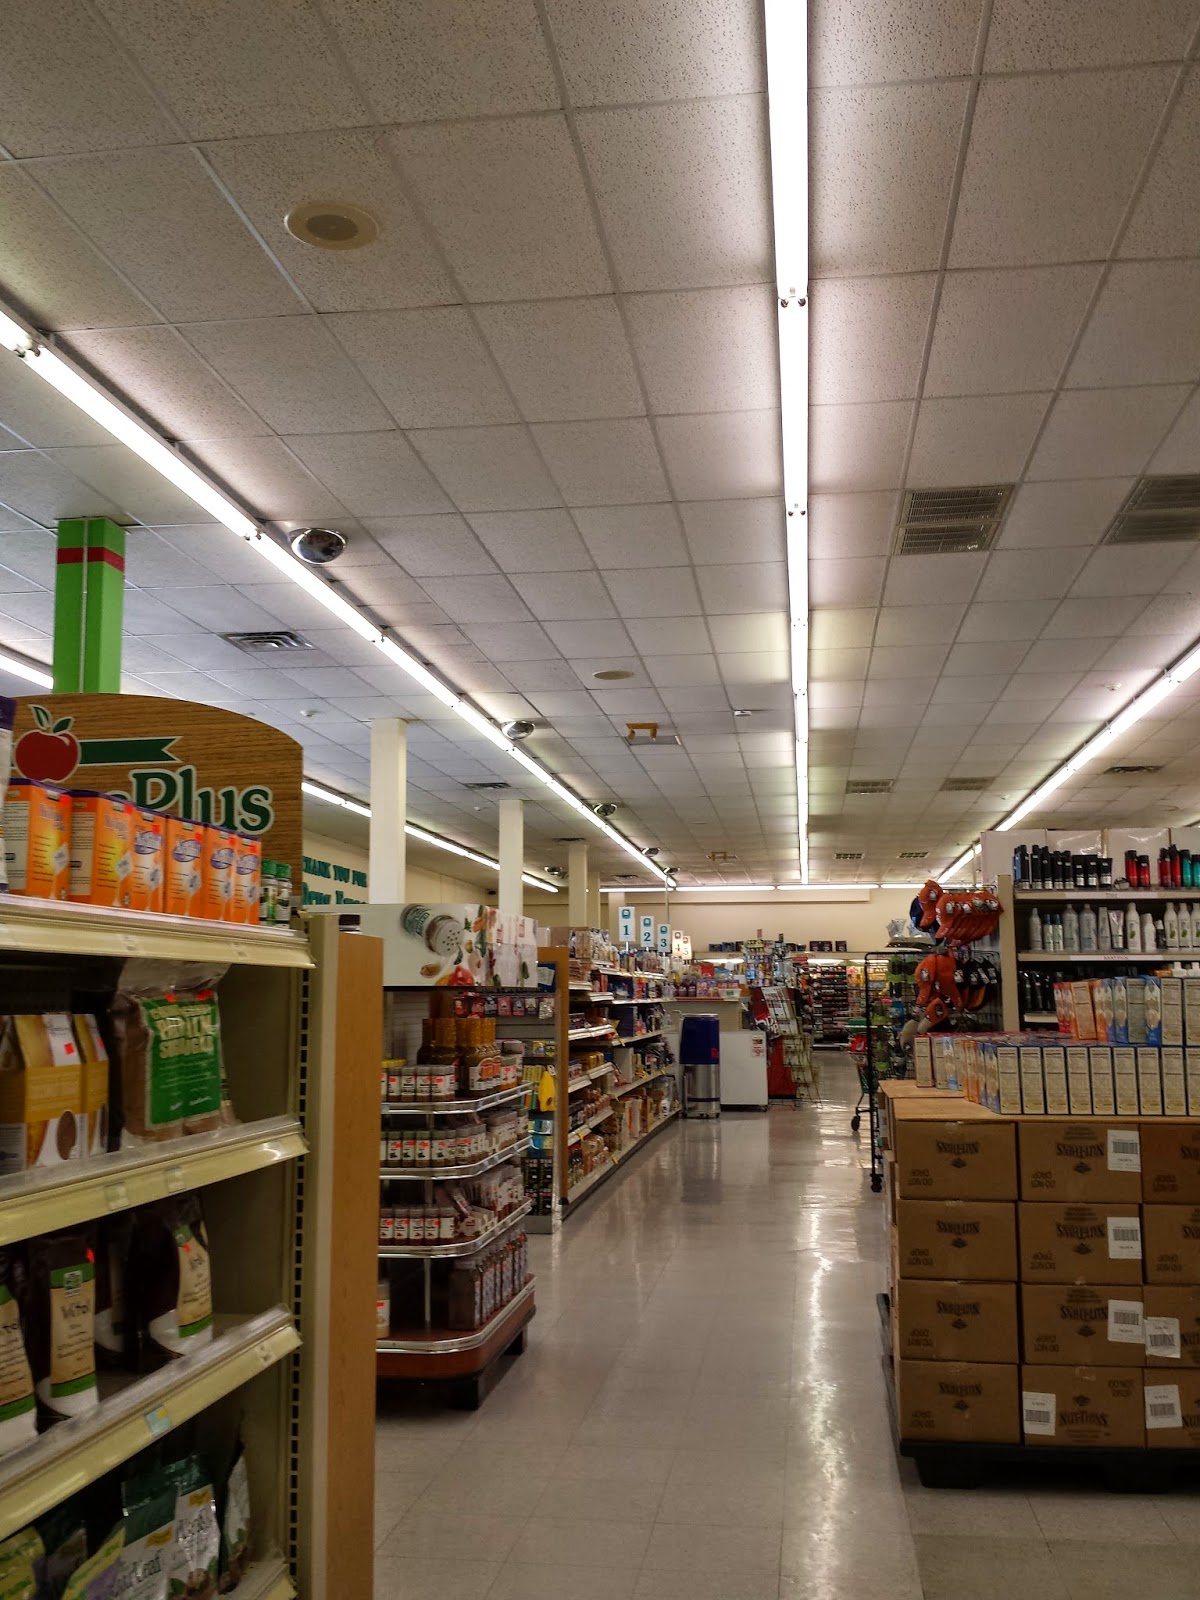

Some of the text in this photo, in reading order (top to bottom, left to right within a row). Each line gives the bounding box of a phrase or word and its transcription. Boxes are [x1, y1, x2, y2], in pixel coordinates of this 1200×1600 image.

[623, 925, 629, 935] 1
[644, 932, 651, 941] 2
[660, 938, 667, 947] 3
